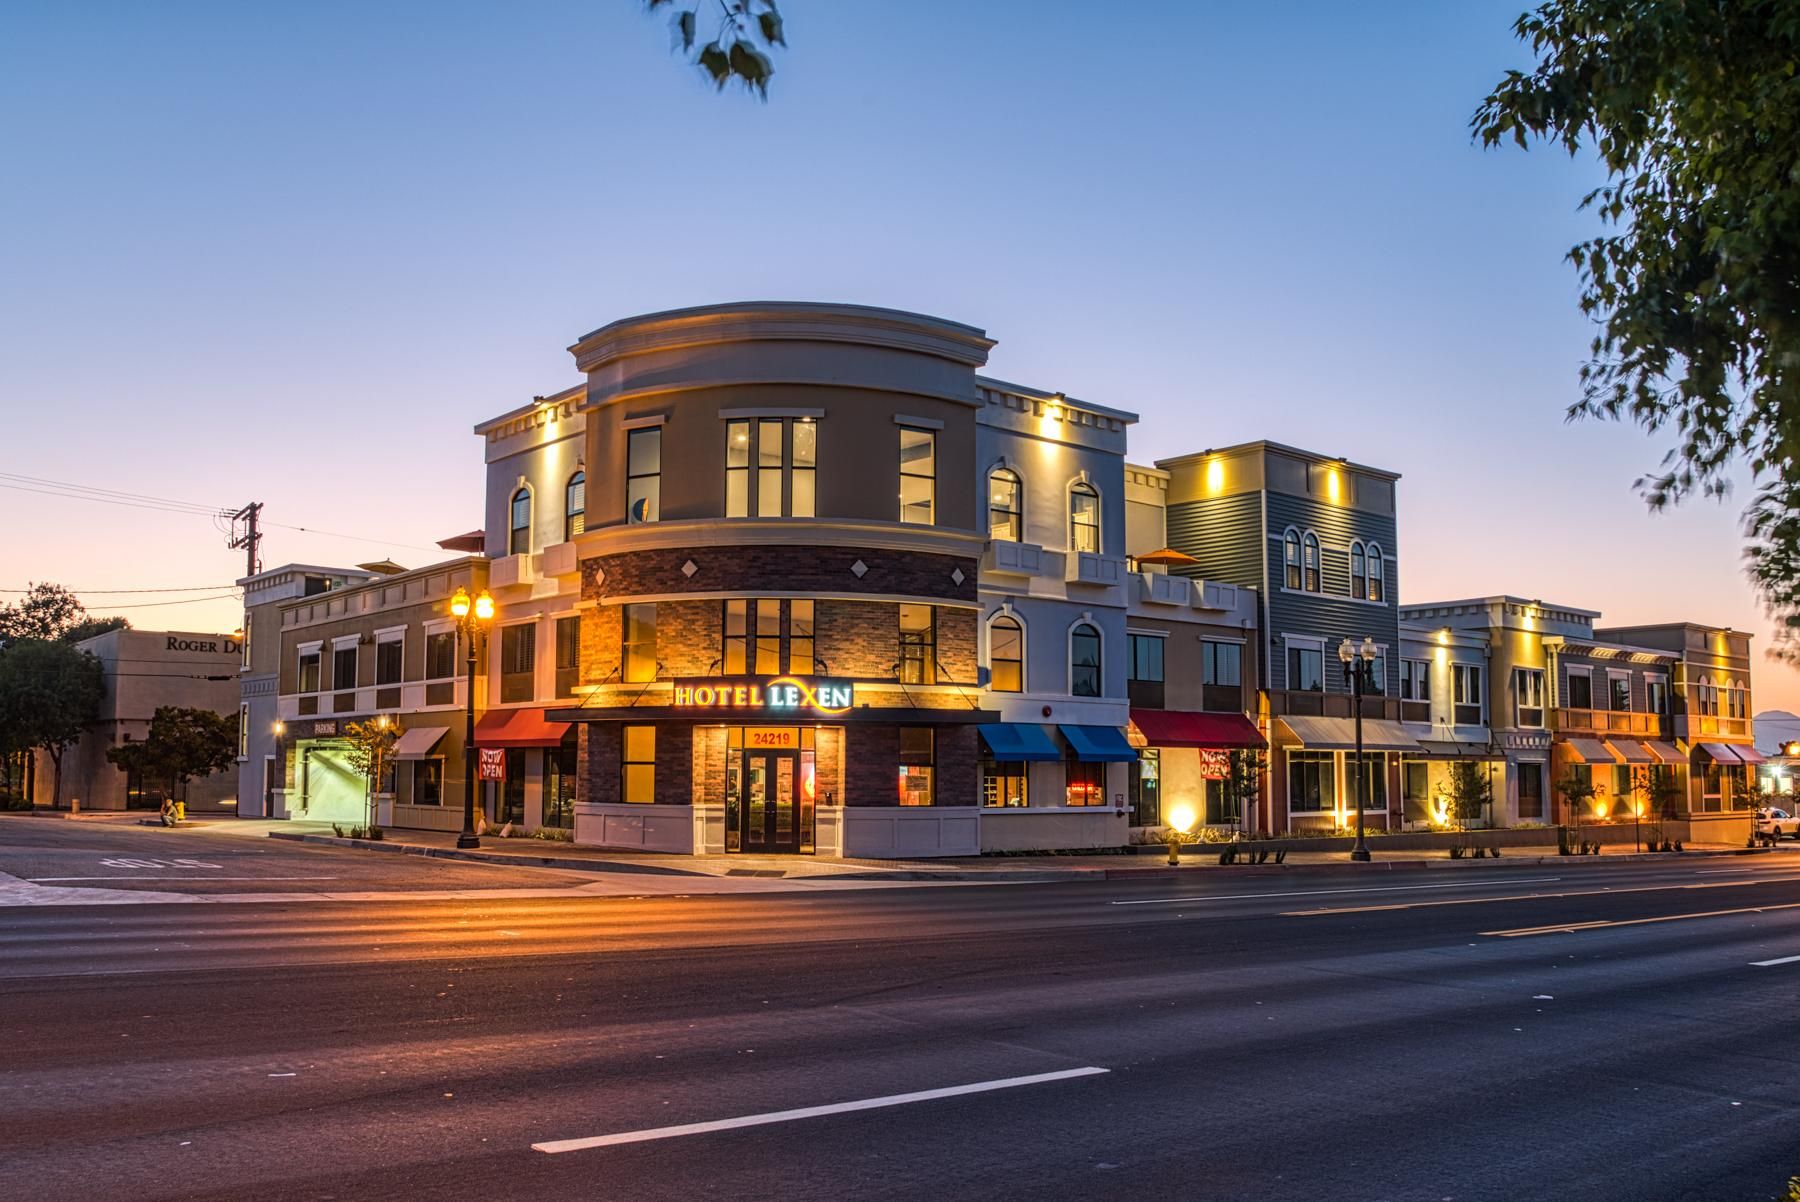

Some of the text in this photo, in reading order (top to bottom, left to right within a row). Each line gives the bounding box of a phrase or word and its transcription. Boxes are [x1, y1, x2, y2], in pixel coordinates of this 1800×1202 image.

[166, 636, 217, 653] ROGER
[674, 678, 852, 713] HOTEL LEXEN
[753, 732, 790, 745] 24219
[482, 751, 503, 763] NOW
[99, 858, 224, 869] STOP
